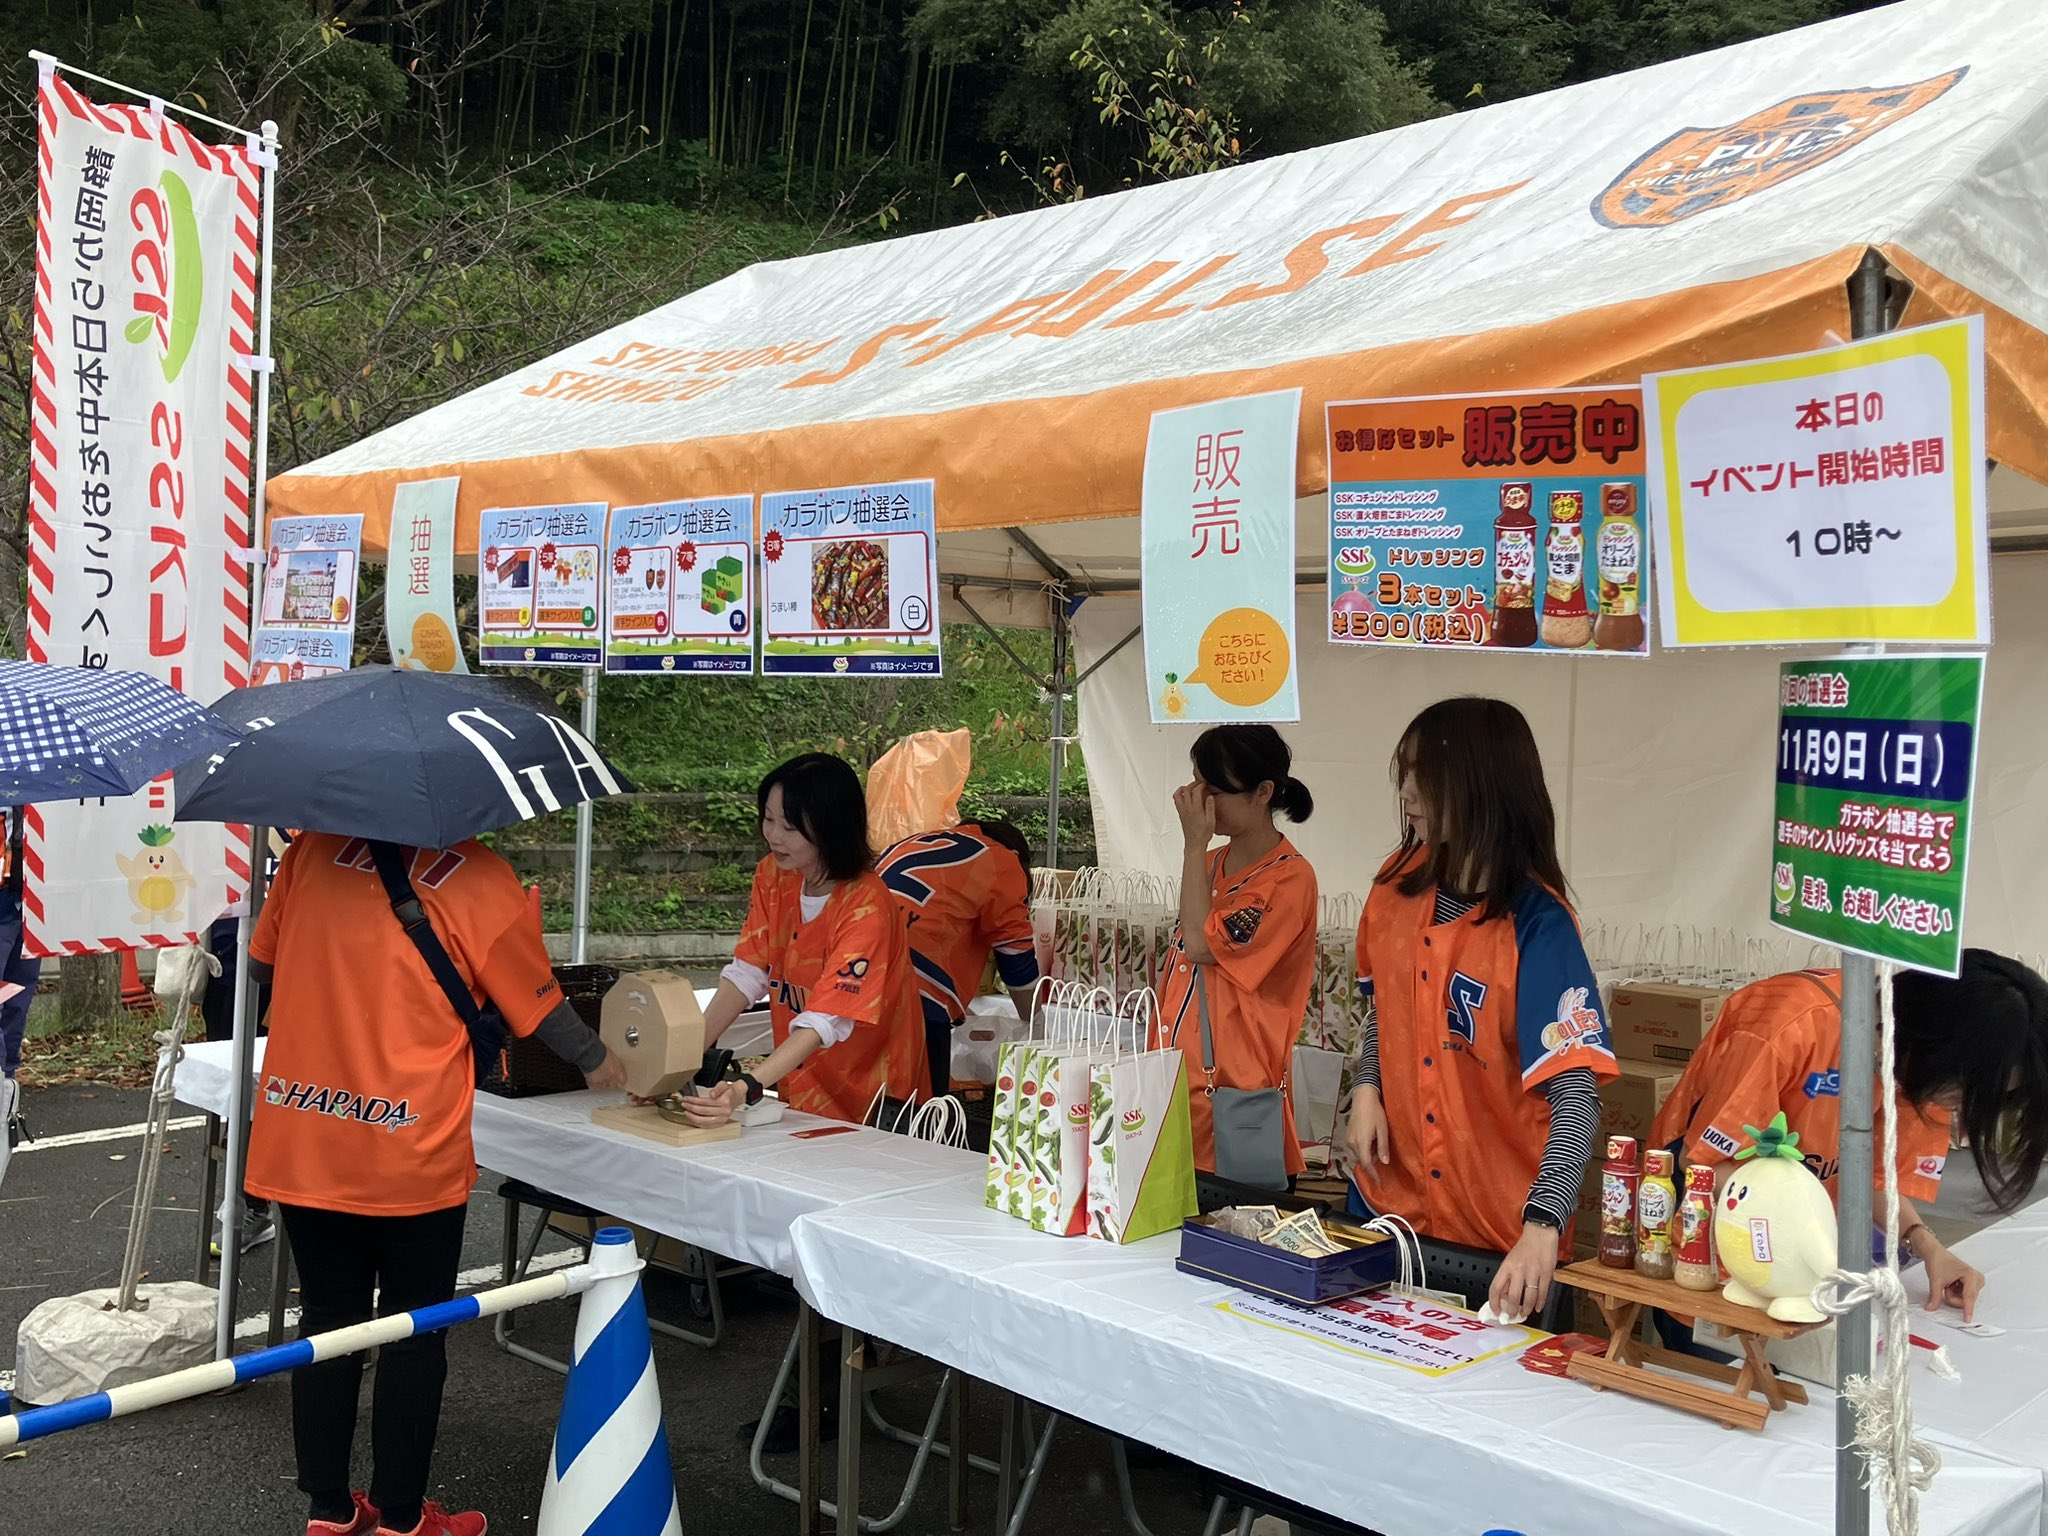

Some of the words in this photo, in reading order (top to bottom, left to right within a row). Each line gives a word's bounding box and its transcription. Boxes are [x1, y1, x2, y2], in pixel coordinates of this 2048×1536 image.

[1795, 391, 1885, 433] 本日の
[1335, 425, 1454, 452] お得なセット
[1462, 399, 1639, 467] 販売中
[1690, 437, 1945, 496] イベント開始時間
[1191, 429, 1244, 559] 販売
[1336, 493, 1353, 503] SSK
[628, 507, 732, 539] ガラポン抽選会
[783, 494, 909, 528] ガラポン抽選会
[1336, 511, 1353, 520] SSK
[496, 513, 588, 538] ガラポン抽選会
[1336, 528, 1353, 537] SSK
[408, 513, 432, 595] 抽選
[1341, 547, 1369, 563] SSK
[1388, 548, 1485, 566] ドレッシング
[1552, 563, 1575, 575] ごま
[1379, 573, 1484, 606] 3本セット
[908, 604, 920, 619] 白
[1219, 633, 1266, 648] こちらに
[1214, 650, 1272, 666] おならびく
[1778, 820, 1951, 871] 選手のサイン入りグッズを当てよう
[1843, 886, 1952, 935] お越しください
[283, 1082, 408, 1125] HARADA
[1281, 1236, 1300, 1251] 1000
